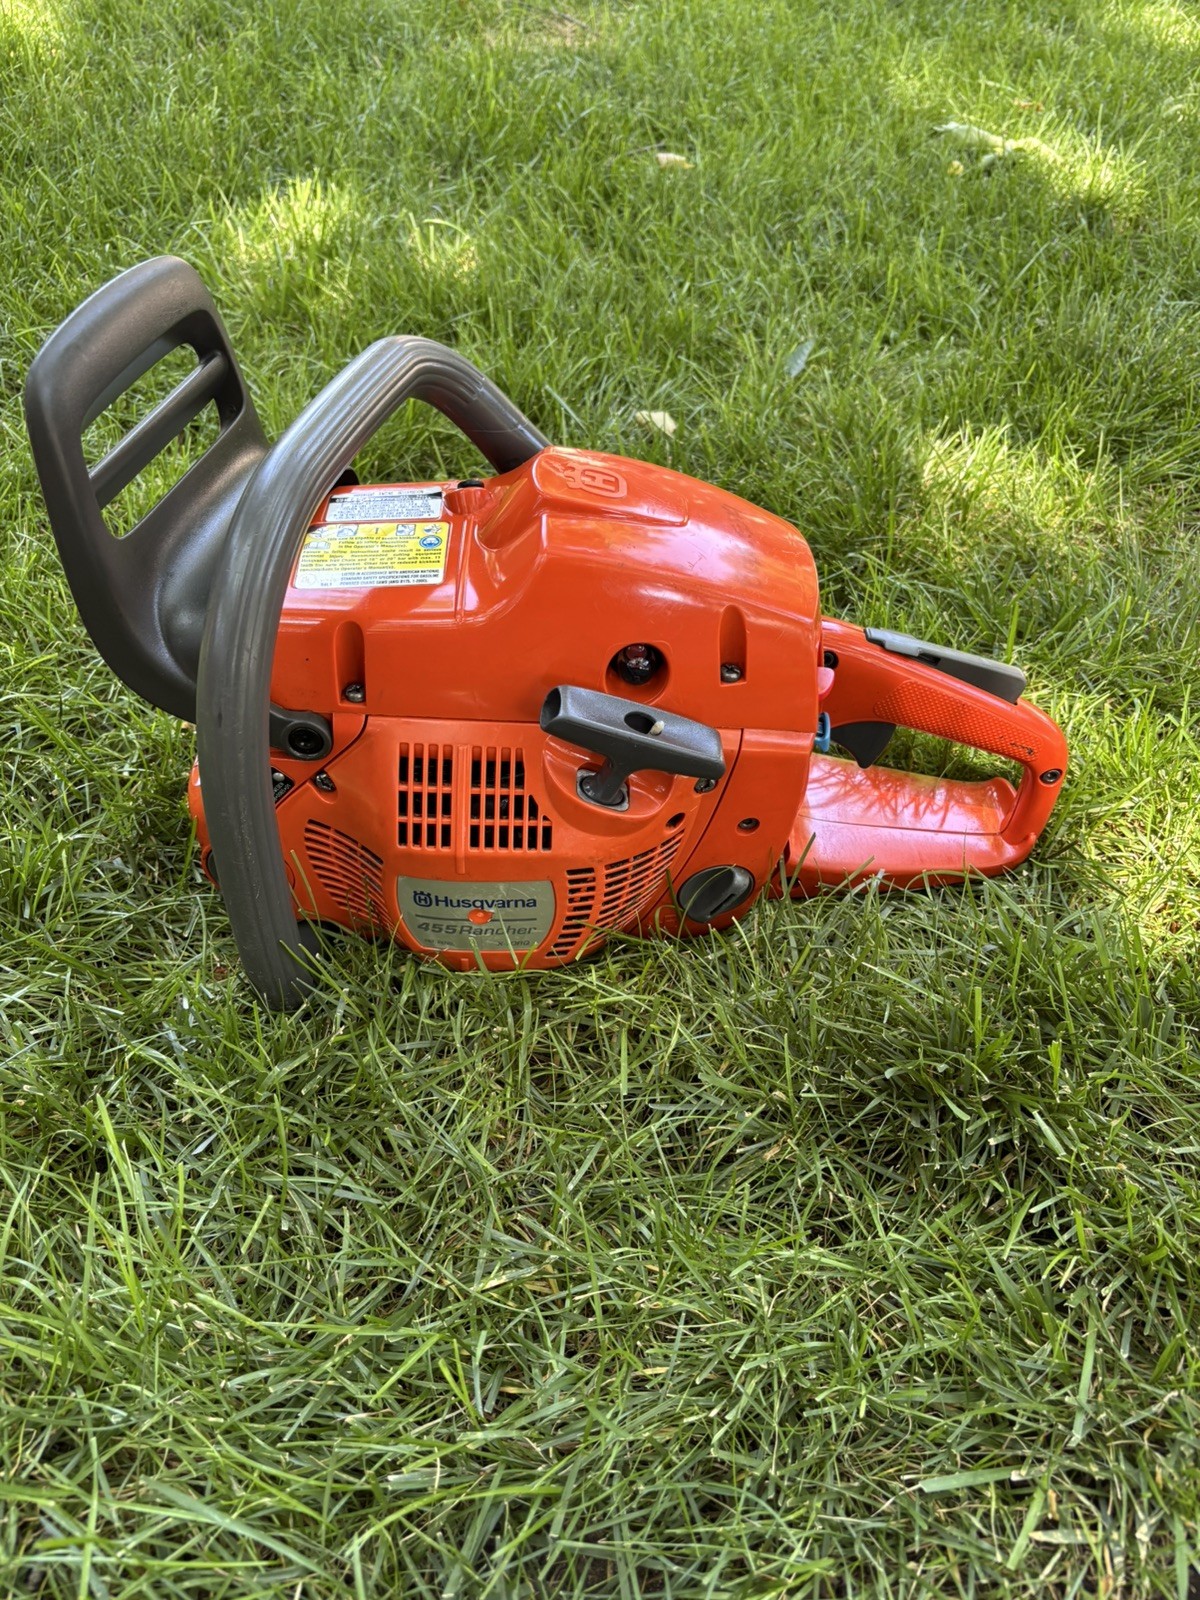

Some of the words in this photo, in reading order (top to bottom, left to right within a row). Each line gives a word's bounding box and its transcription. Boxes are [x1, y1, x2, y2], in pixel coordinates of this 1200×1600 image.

[435, 895, 537, 909] Husqvarna
[418, 922, 457, 934] 455
[459, 925, 537, 936] Rancher
